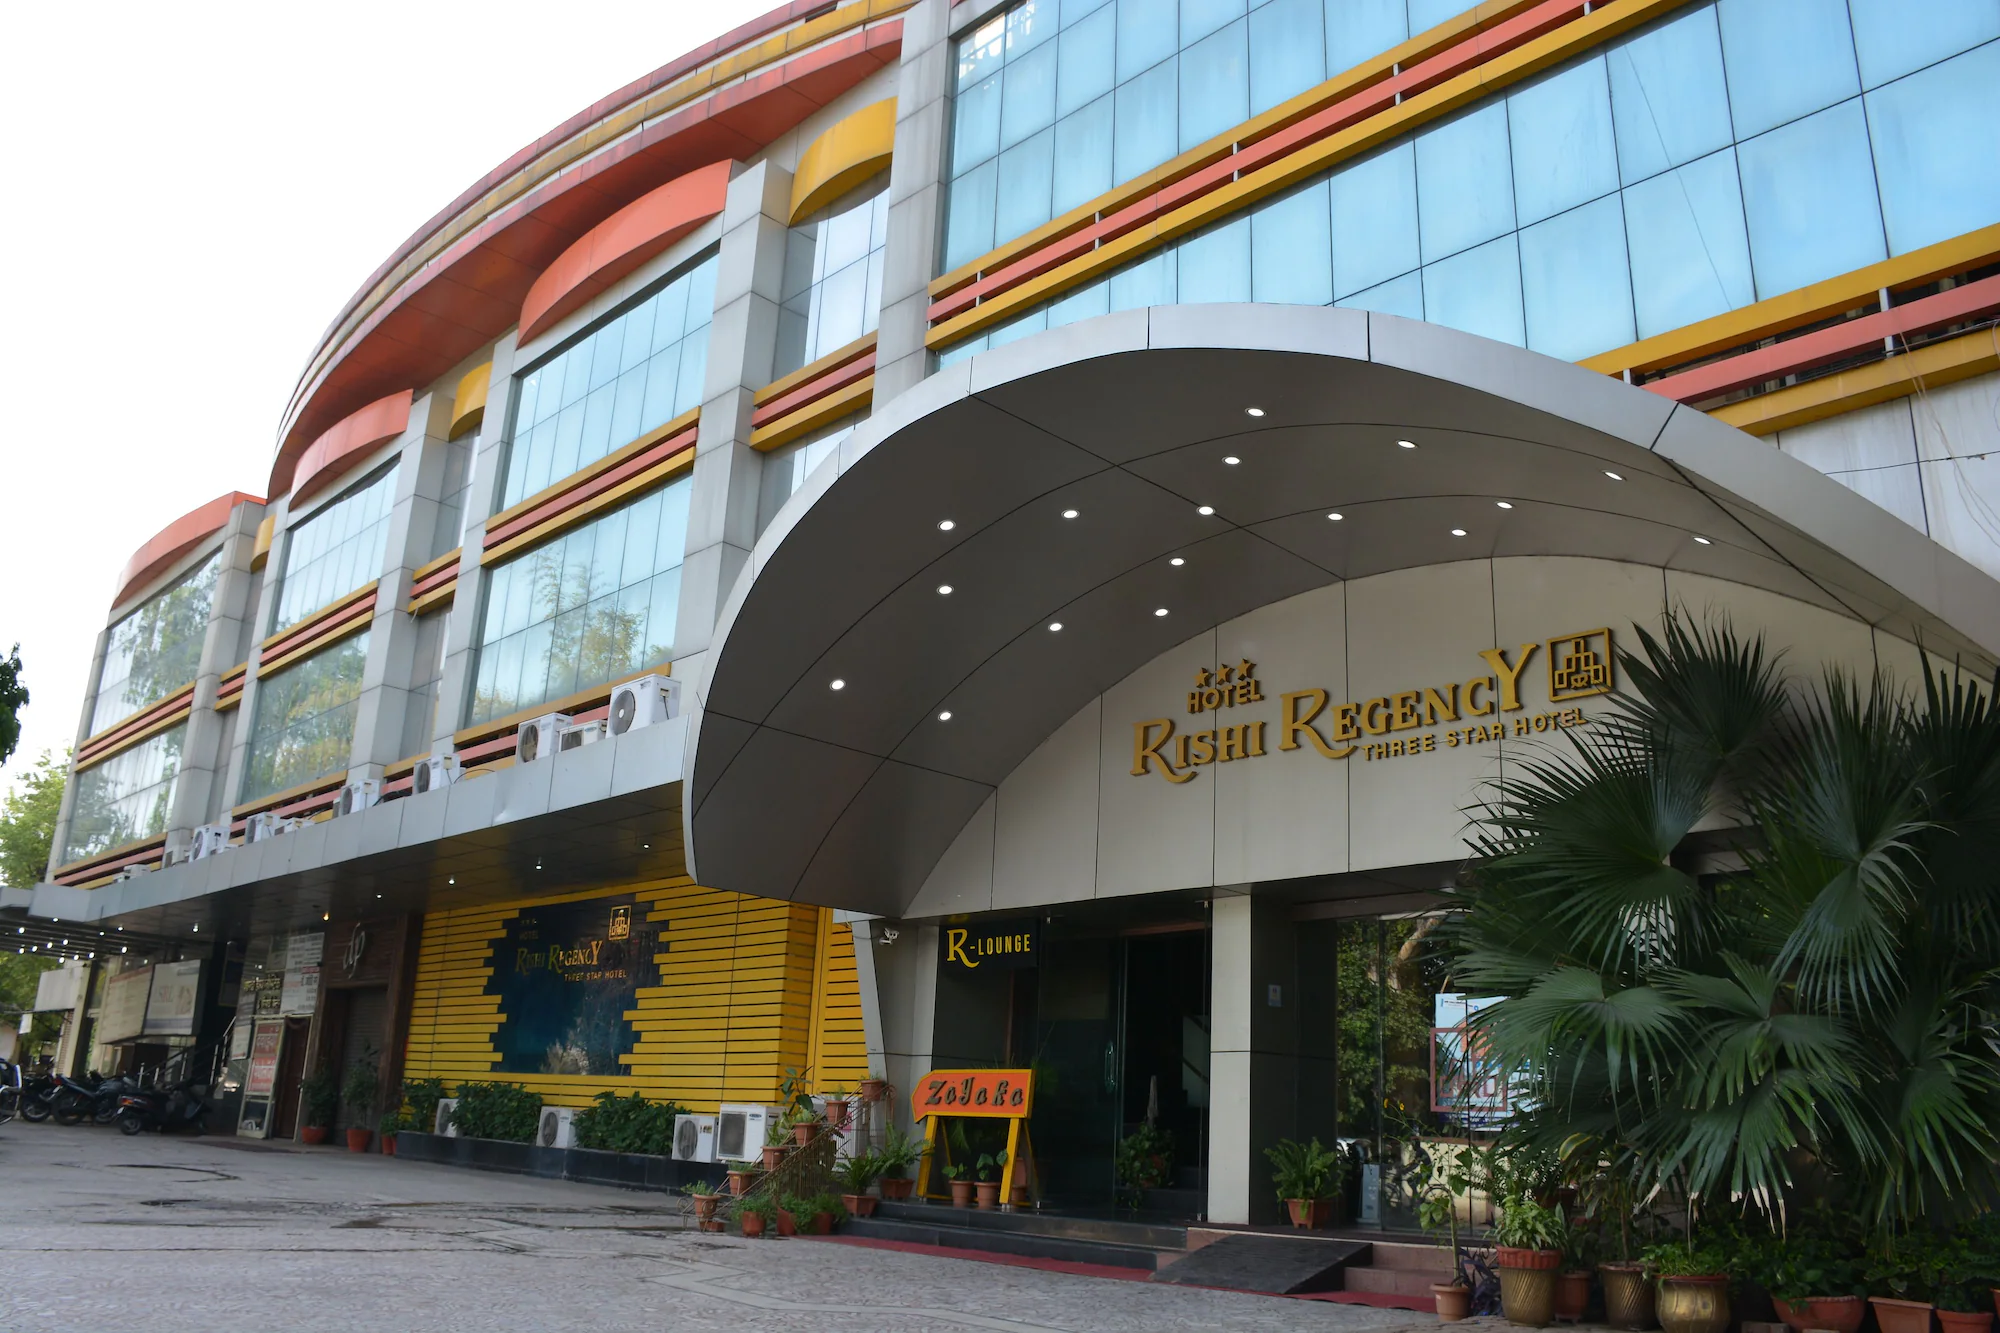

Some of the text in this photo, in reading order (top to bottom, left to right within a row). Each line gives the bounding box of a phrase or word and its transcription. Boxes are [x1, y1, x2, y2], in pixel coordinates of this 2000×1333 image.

[1129, 643, 1541, 784] RISHI REGENCY
[1187, 679, 1264, 714] HOTEL
[1361, 708, 1588, 761] THREE STAR HOTEL
[519, 930, 539, 941] HOTEL
[548, 940, 603, 974] REGENCY
[564, 970, 627, 982] THREE STAR HOTEL
